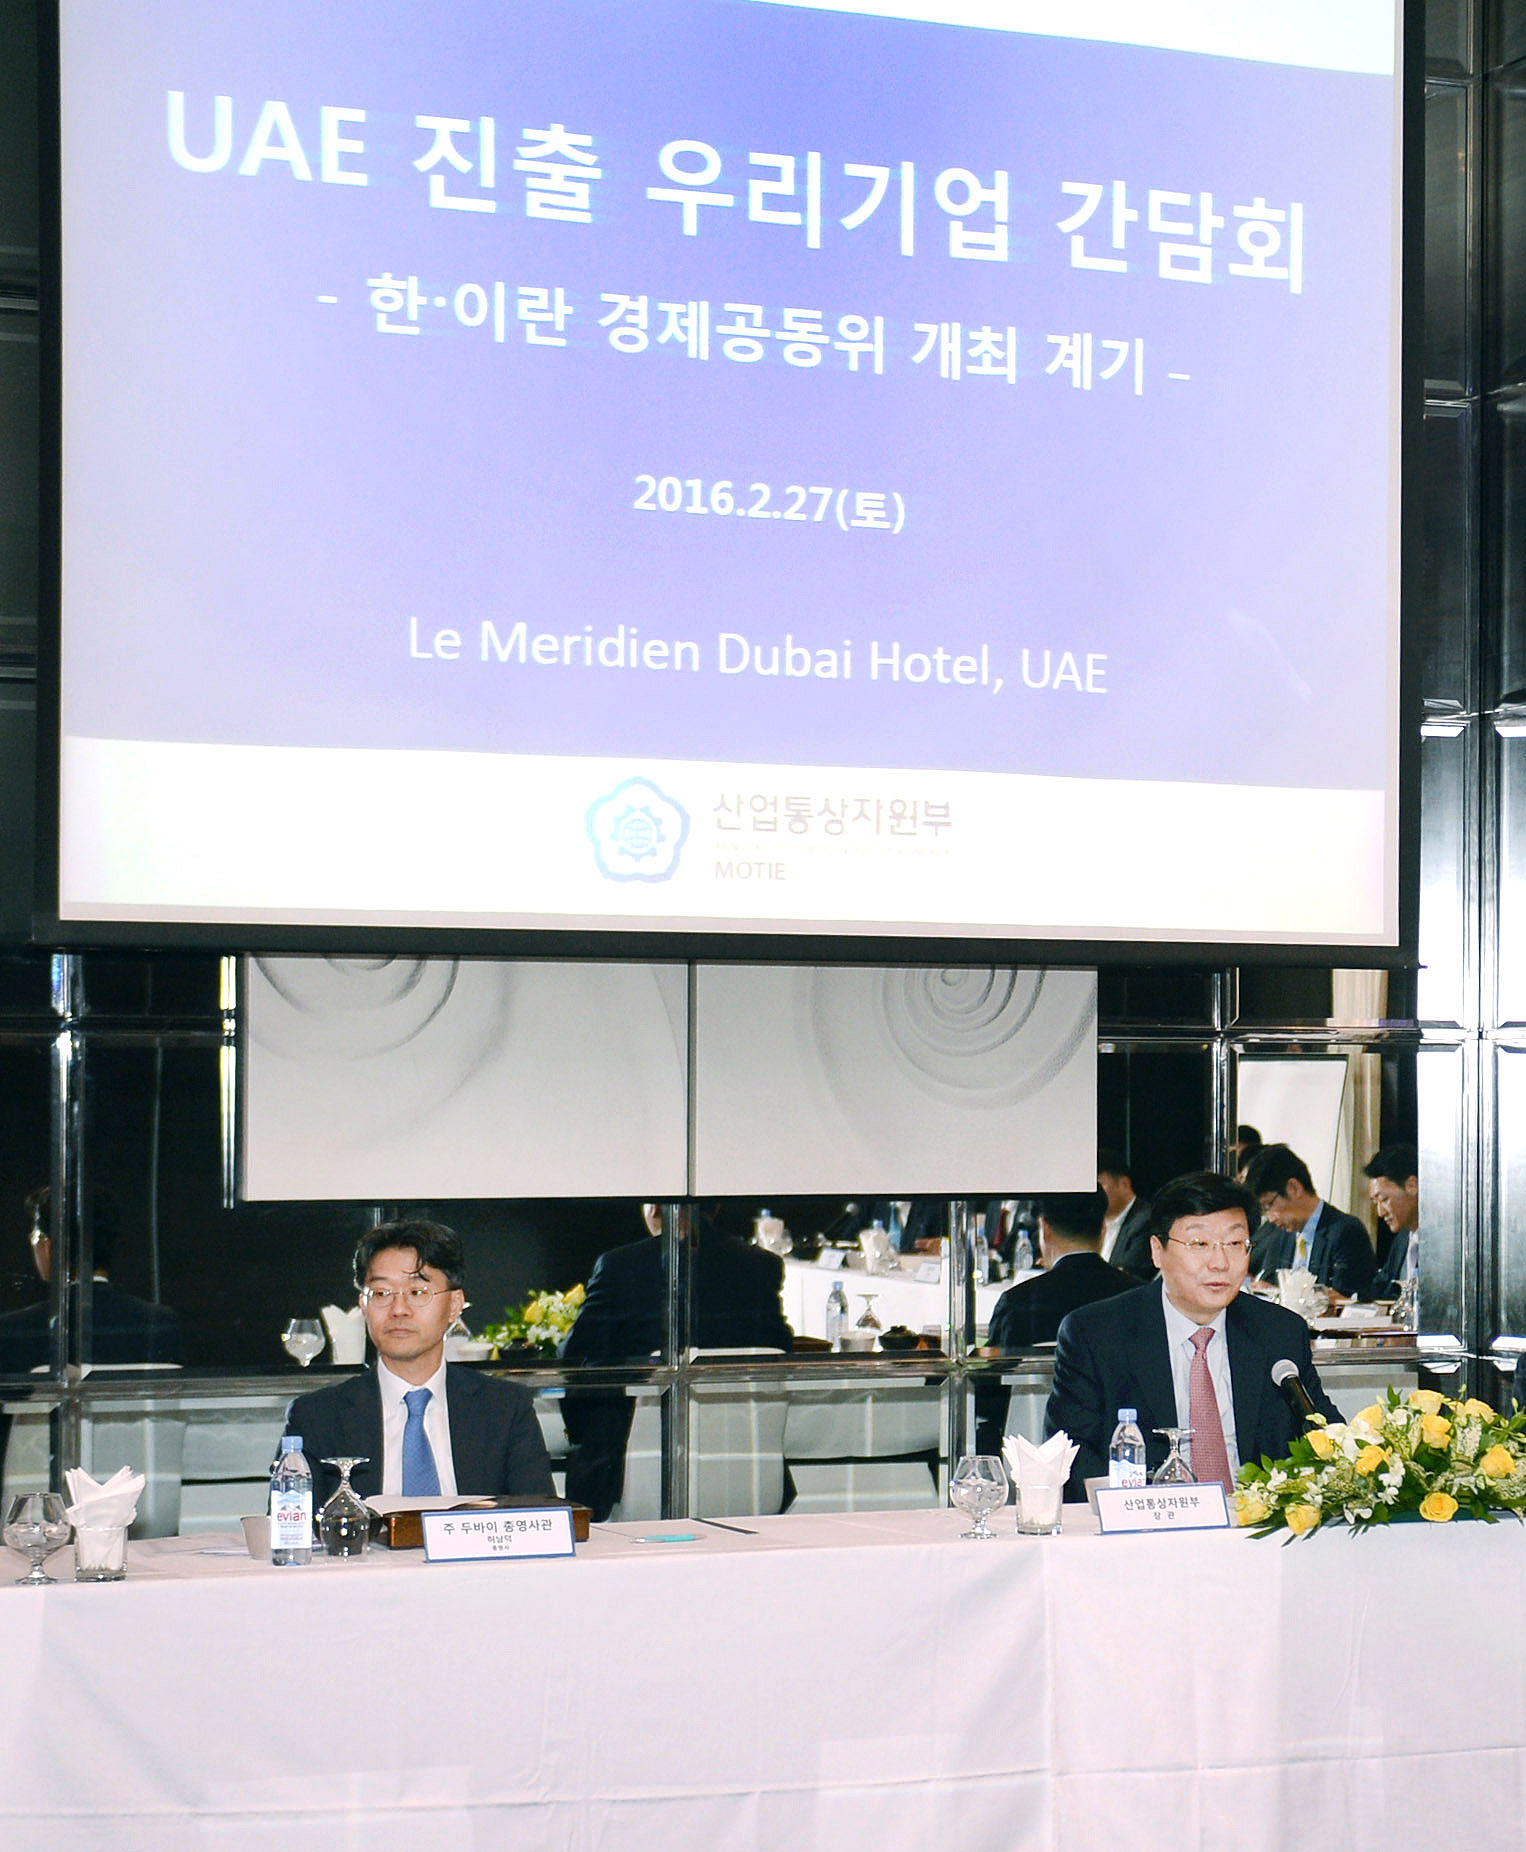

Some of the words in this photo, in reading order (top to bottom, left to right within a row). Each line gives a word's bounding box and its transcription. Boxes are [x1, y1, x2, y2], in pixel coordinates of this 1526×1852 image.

[165, 90, 369, 187] UAE
[412, 114, 602, 224] 진출
[645, 139, 1011, 263] 우리기업
[1056, 179, 1304, 295] 간담회
[366, 272, 574, 348] 한·이란
[598, 291, 885, 376] 경제공동위
[911, 320, 1018, 385] 개최
[1044, 331, 1145, 396] 계기
[632, 474, 907, 535] 2016.2.27(토)
[407, 616, 462, 661] Le
[480, 620, 701, 673] Meridien
[718, 631, 853, 682] Dubai
[869, 640, 1005, 695] Hotel,
[1020, 648, 1109, 695] UAE
[712, 791, 953, 839] 산업통상자원부
[714, 860, 787, 881] MOTIE
[1121, 1477, 1146, 1489] evia
[277, 1510, 307, 1522] evian
[1123, 1496, 1201, 1511] 산업통상자원부
[443, 1522, 456, 1535] 주
[460, 1520, 499, 1535] 두바이
[503, 1518, 553, 1534] 총영사관
